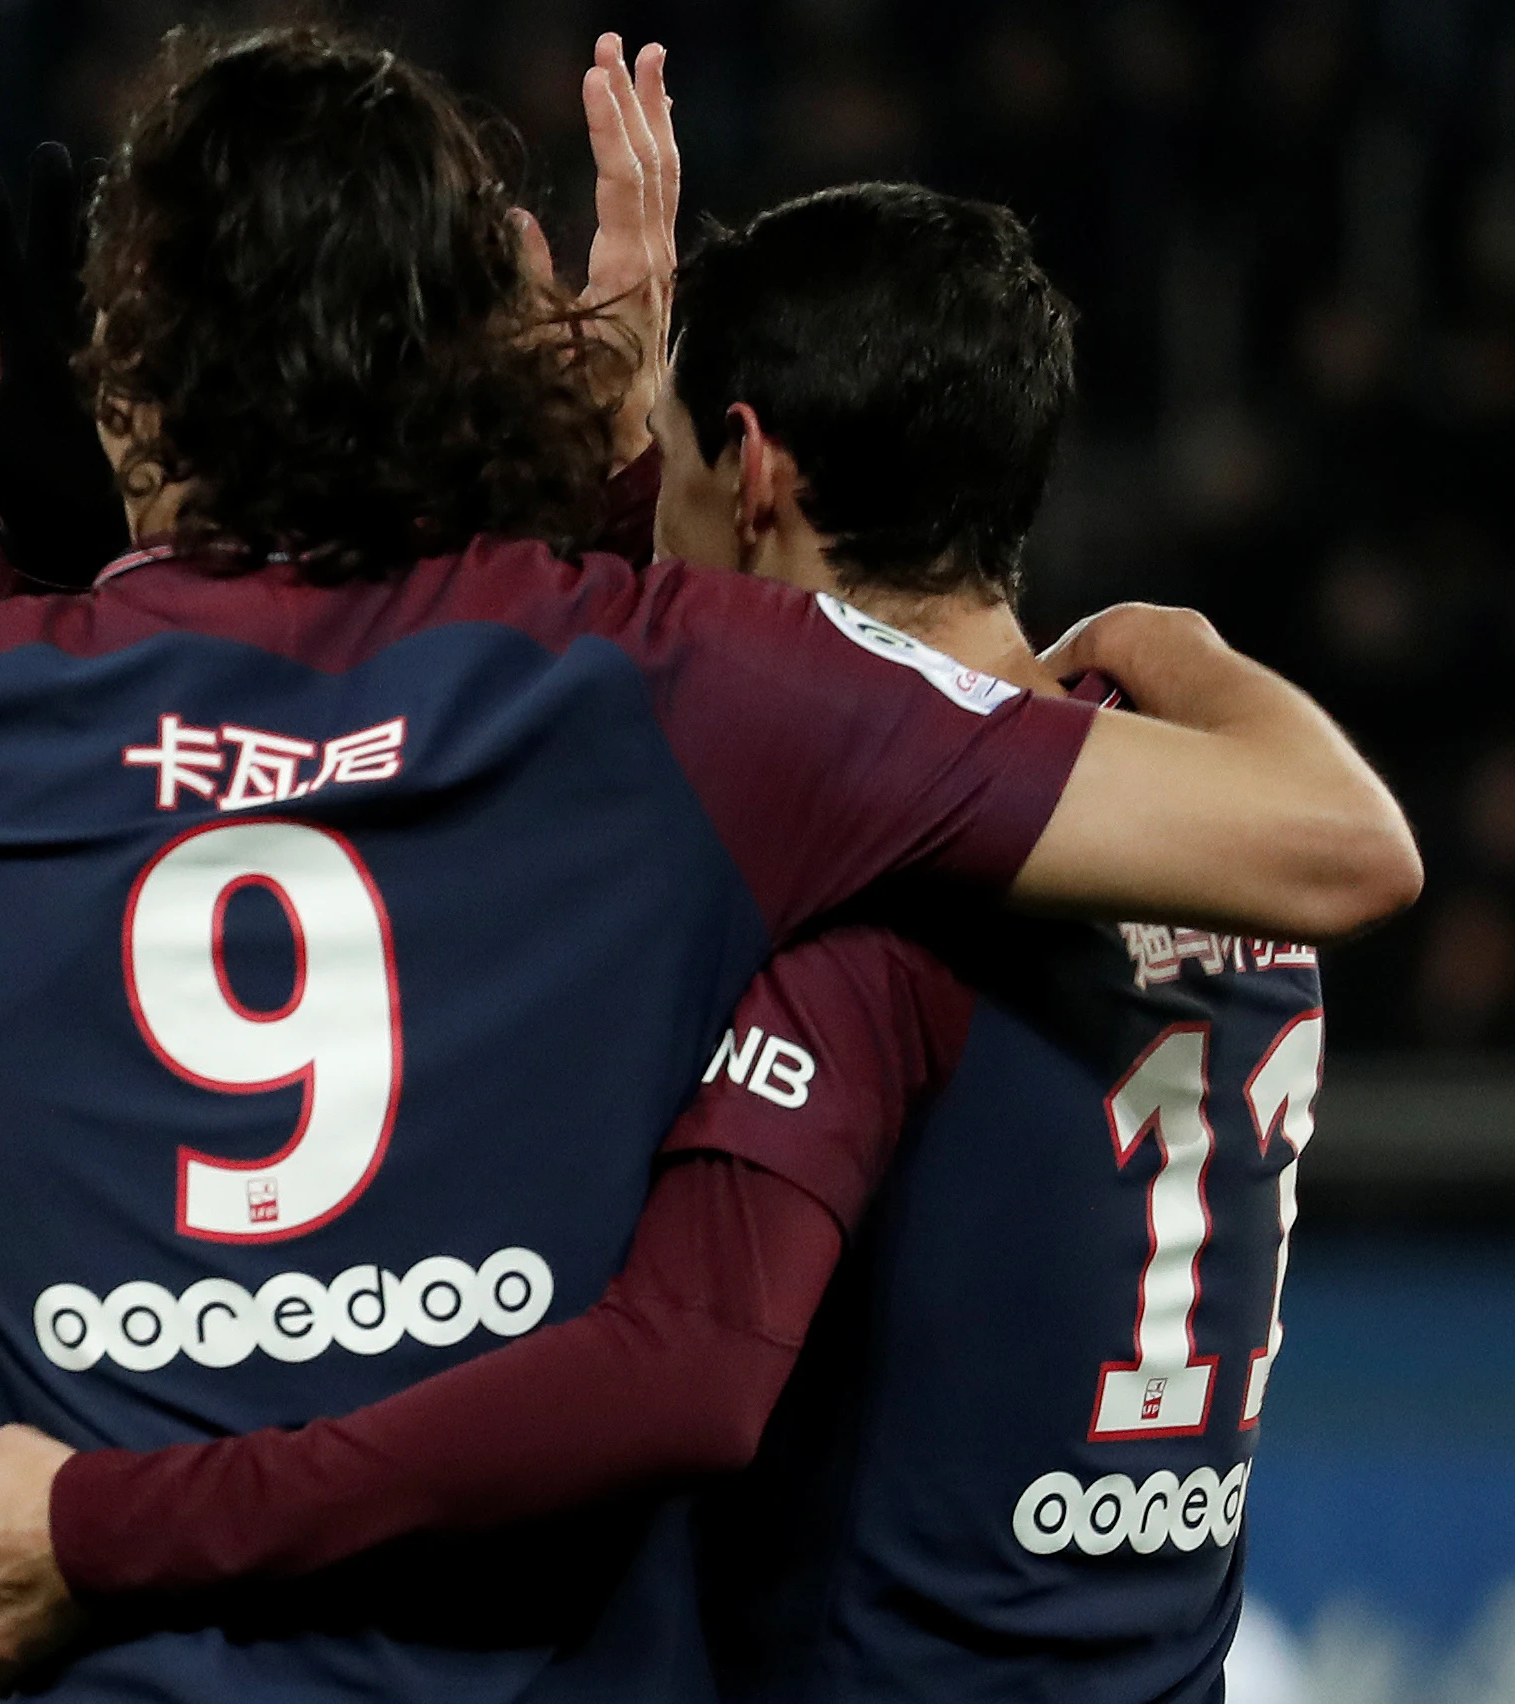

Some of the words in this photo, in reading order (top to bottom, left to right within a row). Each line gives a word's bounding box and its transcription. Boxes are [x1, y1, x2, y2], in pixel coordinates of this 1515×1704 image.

[121, 712, 407, 812] 卡瓦尼
[122, 815, 403, 1245] 9
[46, 1260, 536, 1355] ooredoo
[1087, 1006, 1325, 1443] 11
